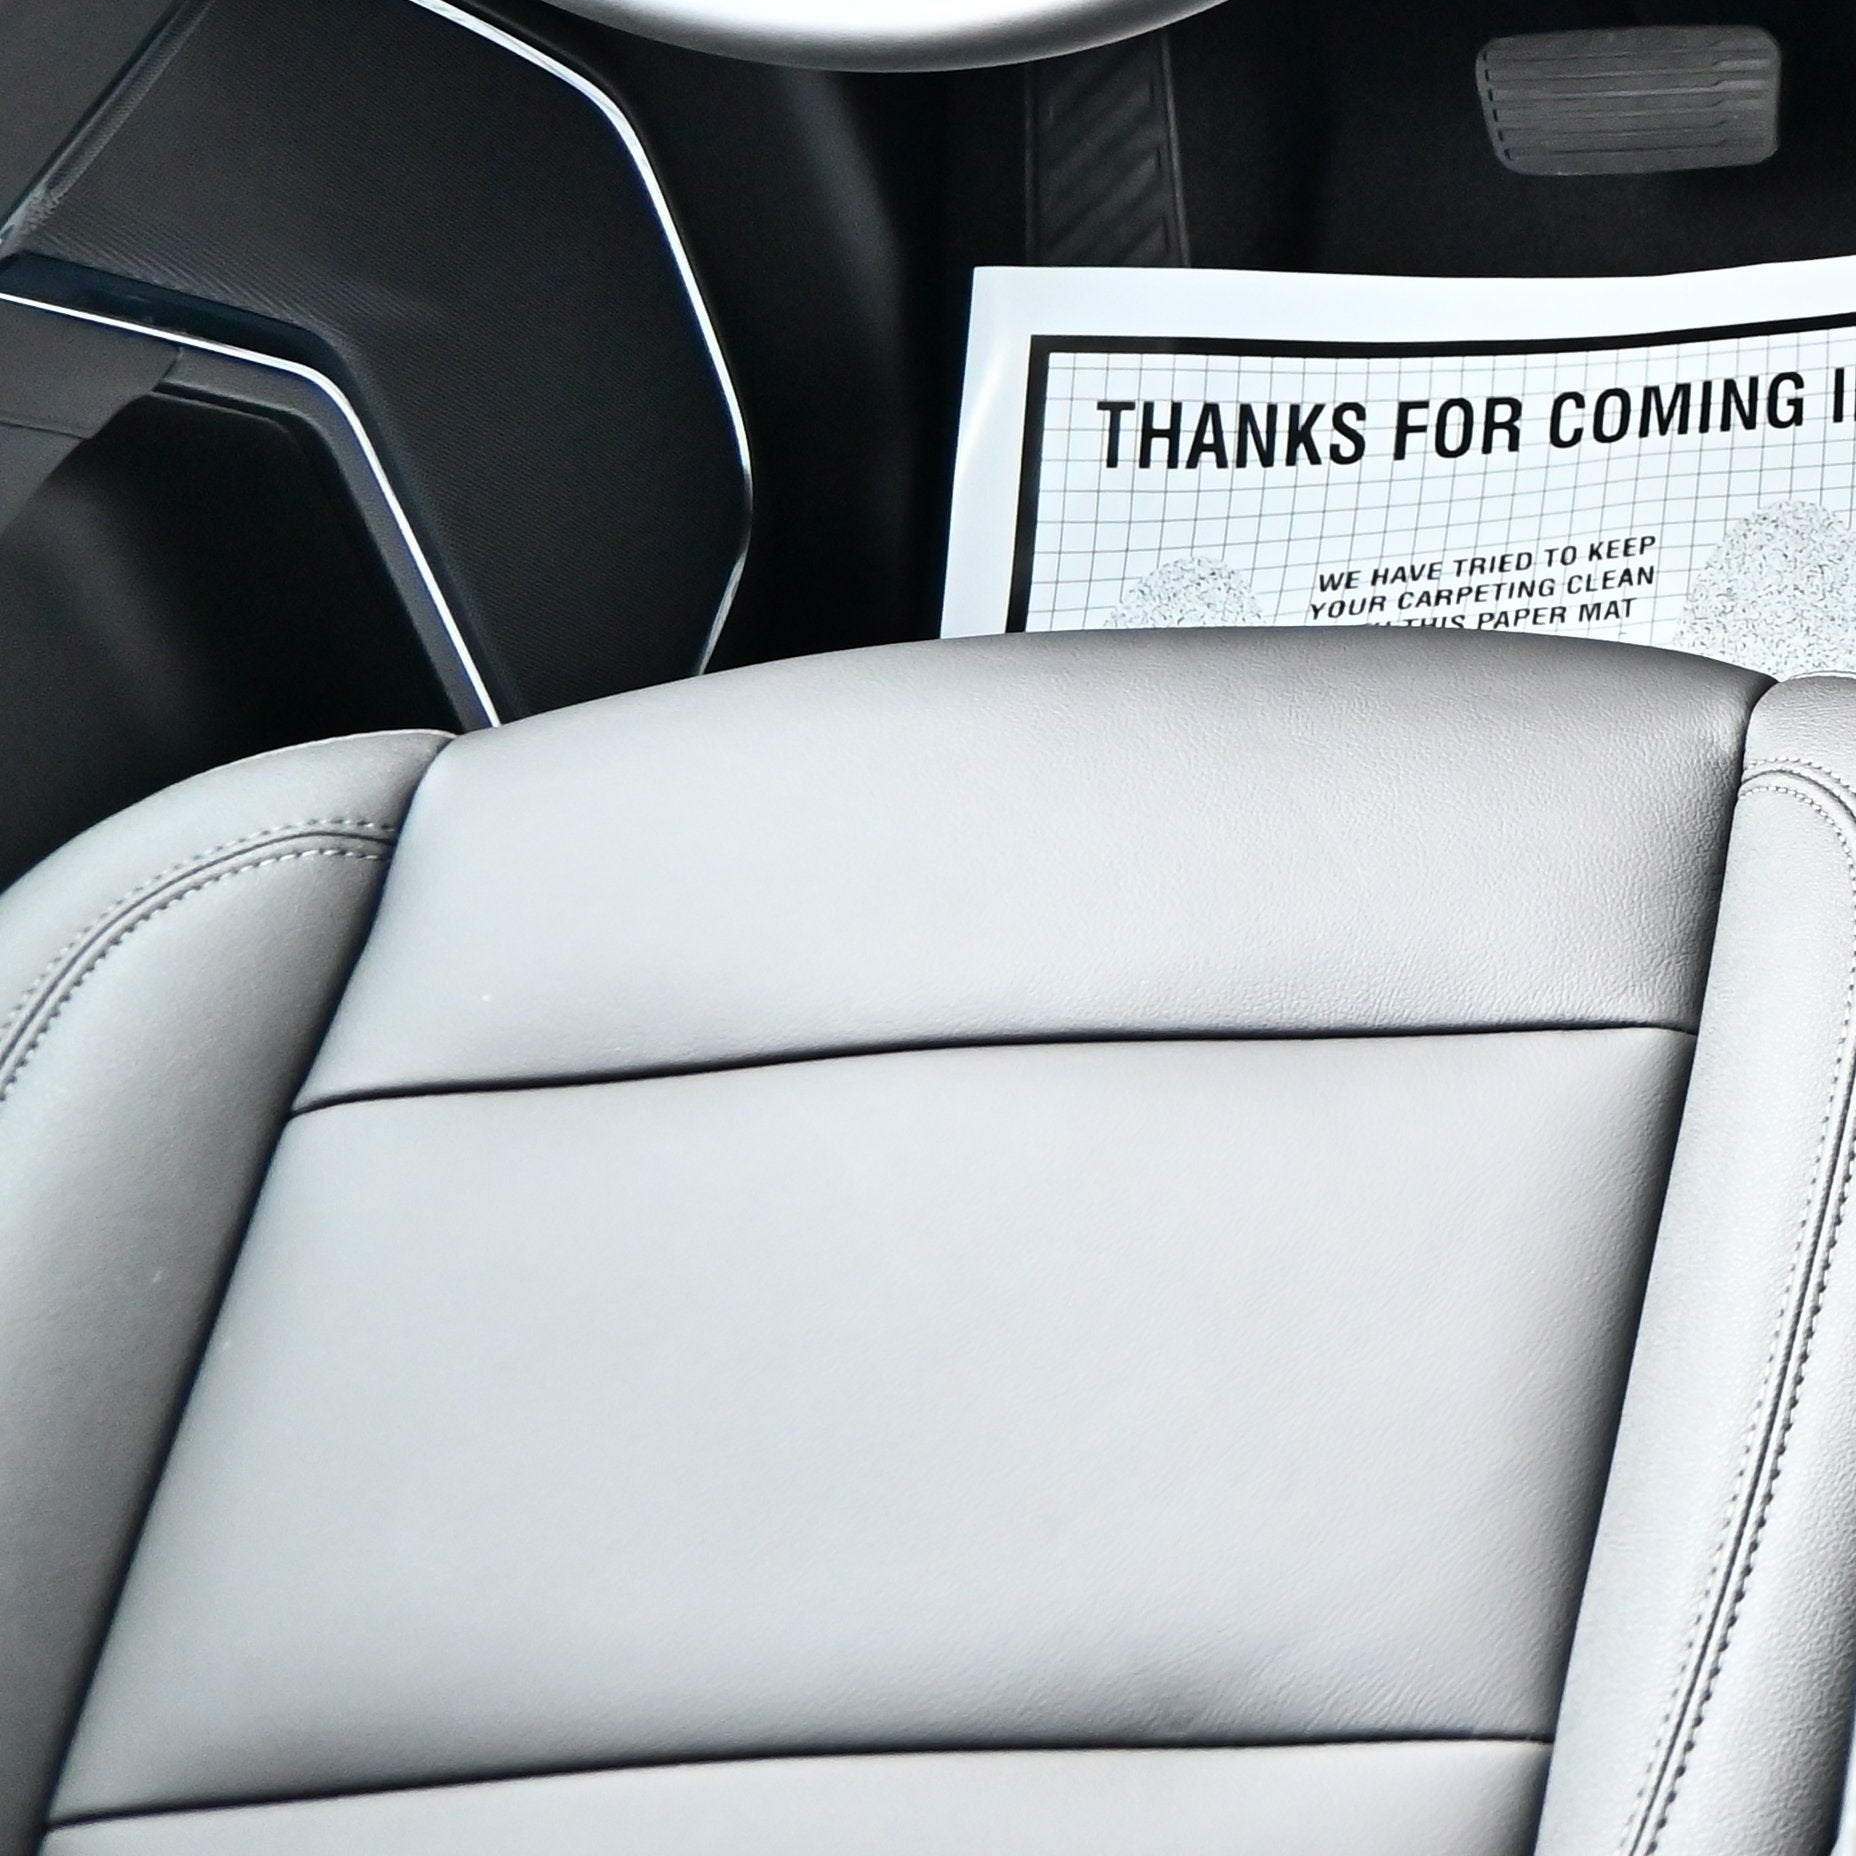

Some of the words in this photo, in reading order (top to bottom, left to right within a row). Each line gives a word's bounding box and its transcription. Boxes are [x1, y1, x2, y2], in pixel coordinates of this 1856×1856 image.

[1097, 401, 1366, 469] THANKS
[1394, 396, 1523, 461] FOR
[1549, 370, 1805, 449] COMING
[1318, 569, 1361, 593] WE
[1370, 561, 1443, 587] HAVE
[1452, 551, 1533, 578] TRIED
[1544, 545, 1578, 568] TO
[1587, 535, 1656, 562] KEEP
[1310, 594, 1387, 622] YOUR
[1397, 577, 1556, 611] CARPETING
[1566, 565, 1655, 595] CLEAN
[1477, 604, 1567, 631] PAPER
[1578, 597, 1638, 623] MAT
